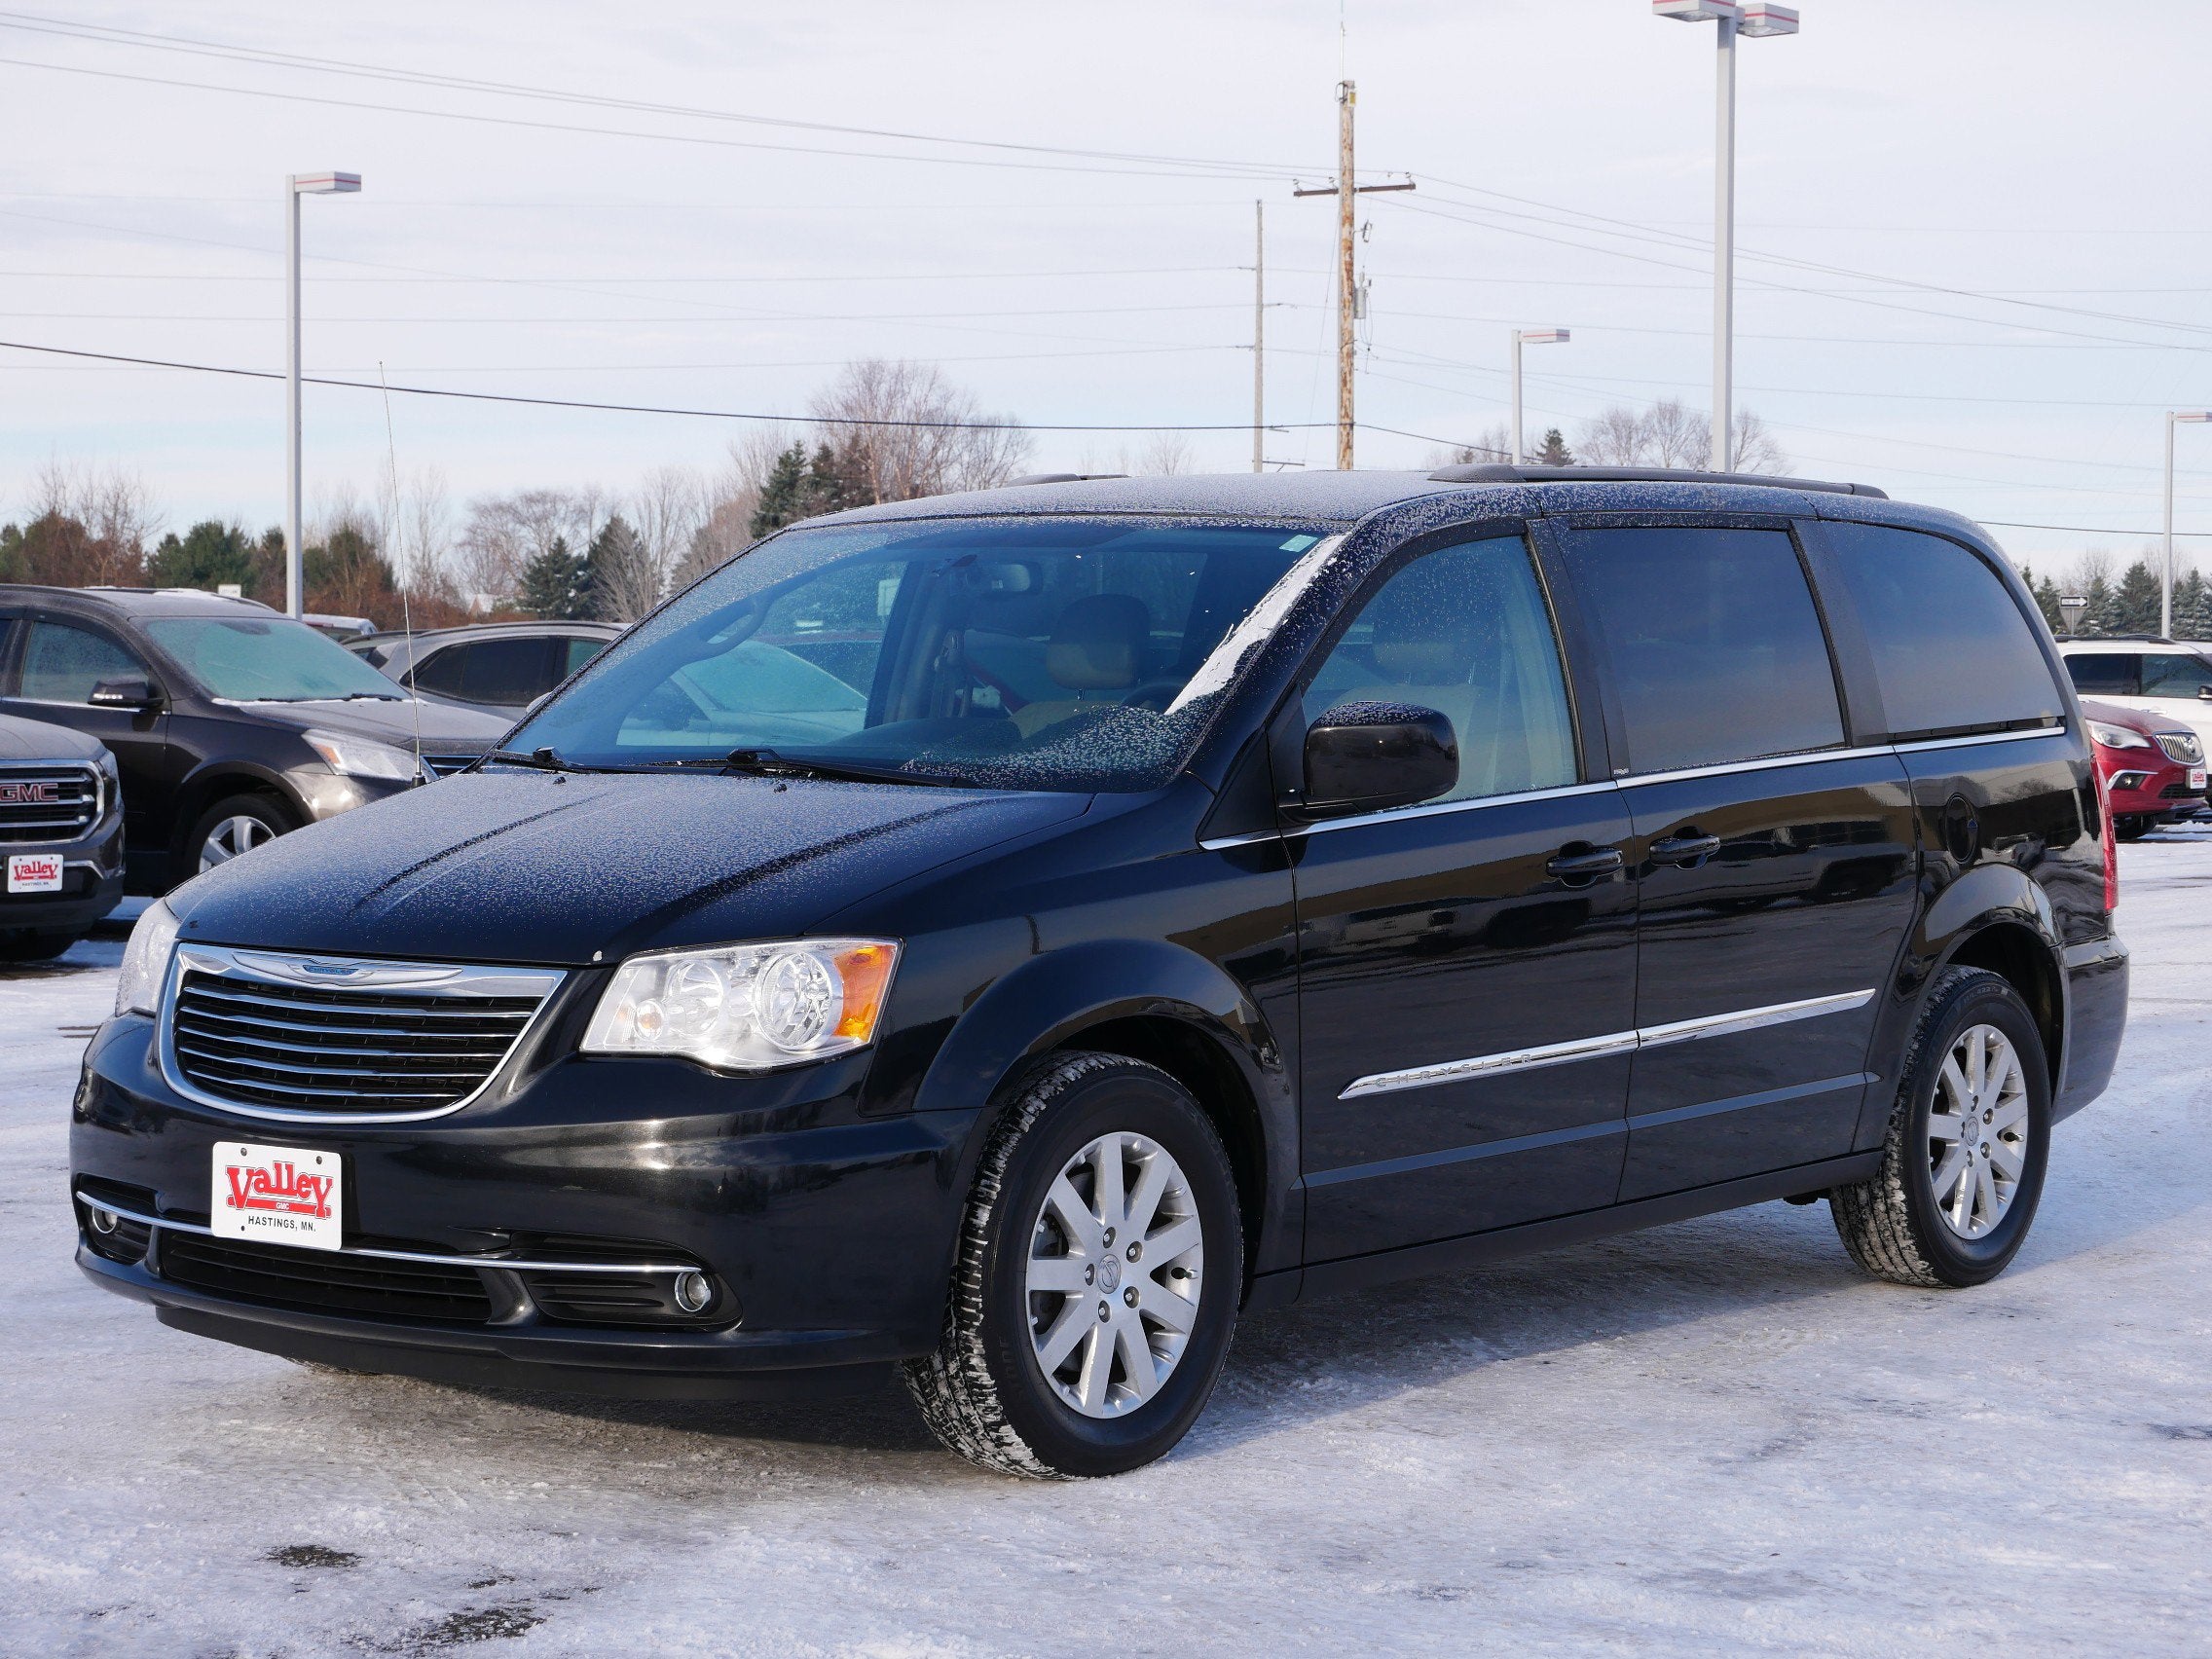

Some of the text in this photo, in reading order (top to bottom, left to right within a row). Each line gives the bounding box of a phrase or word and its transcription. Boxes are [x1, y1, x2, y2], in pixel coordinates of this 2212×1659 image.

[0, 783, 58, 802] GMC
[14, 861, 58, 881] Valley
[1376, 1053, 1531, 1088] CHRYSLER
[226, 1161, 333, 1219] Valley
[247, 1215, 316, 1233] HASTINGS, MN.
